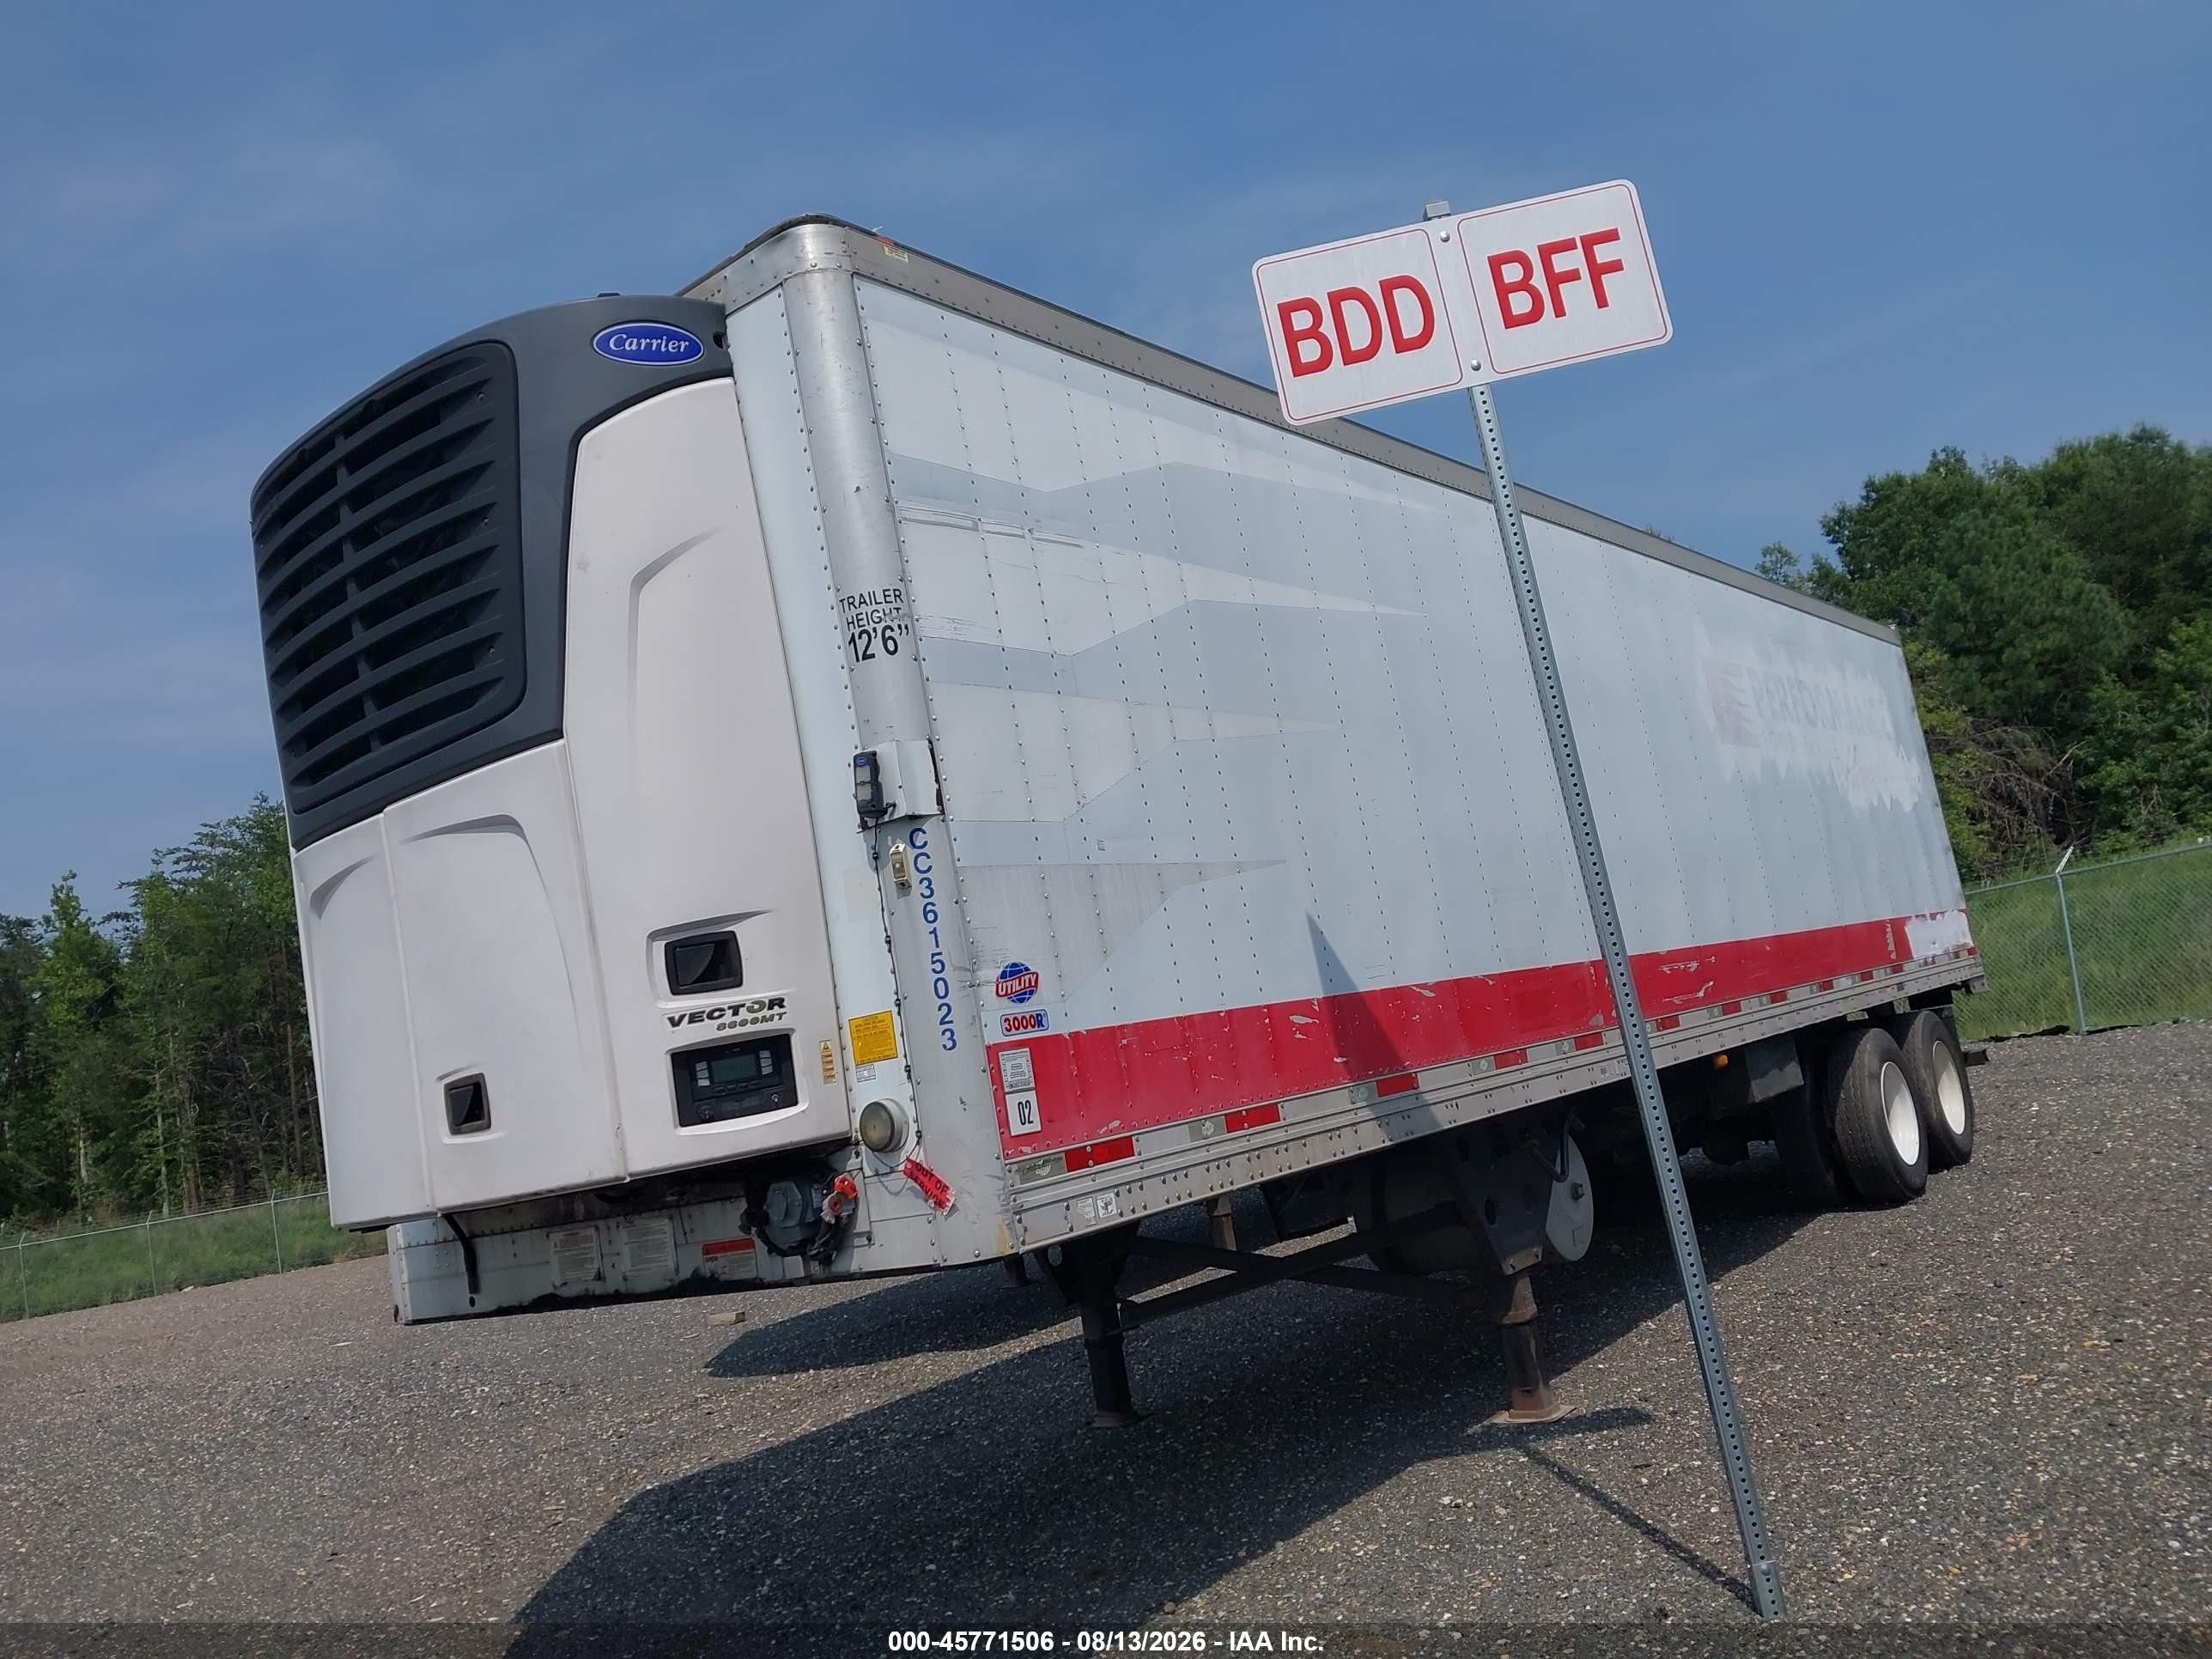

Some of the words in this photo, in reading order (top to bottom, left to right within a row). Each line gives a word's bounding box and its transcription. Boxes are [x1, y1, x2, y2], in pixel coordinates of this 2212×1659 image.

[1277, 274, 1435, 378] BDD
[1486, 228, 1625, 330] BFF
[609, 333, 689, 352] Carrier
[839, 588, 904, 614] TRAILER
[846, 607, 902, 631] HEIGHT
[908, 827, 957, 1052] CC3615023
[998, 974, 1036, 996] UTILITY
[667, 997, 787, 1028] VECTOR
[1018, 1100, 1034, 1126] 02
[915, 1163, 934, 1182] OUT
[935, 1180, 950, 1194] OF
